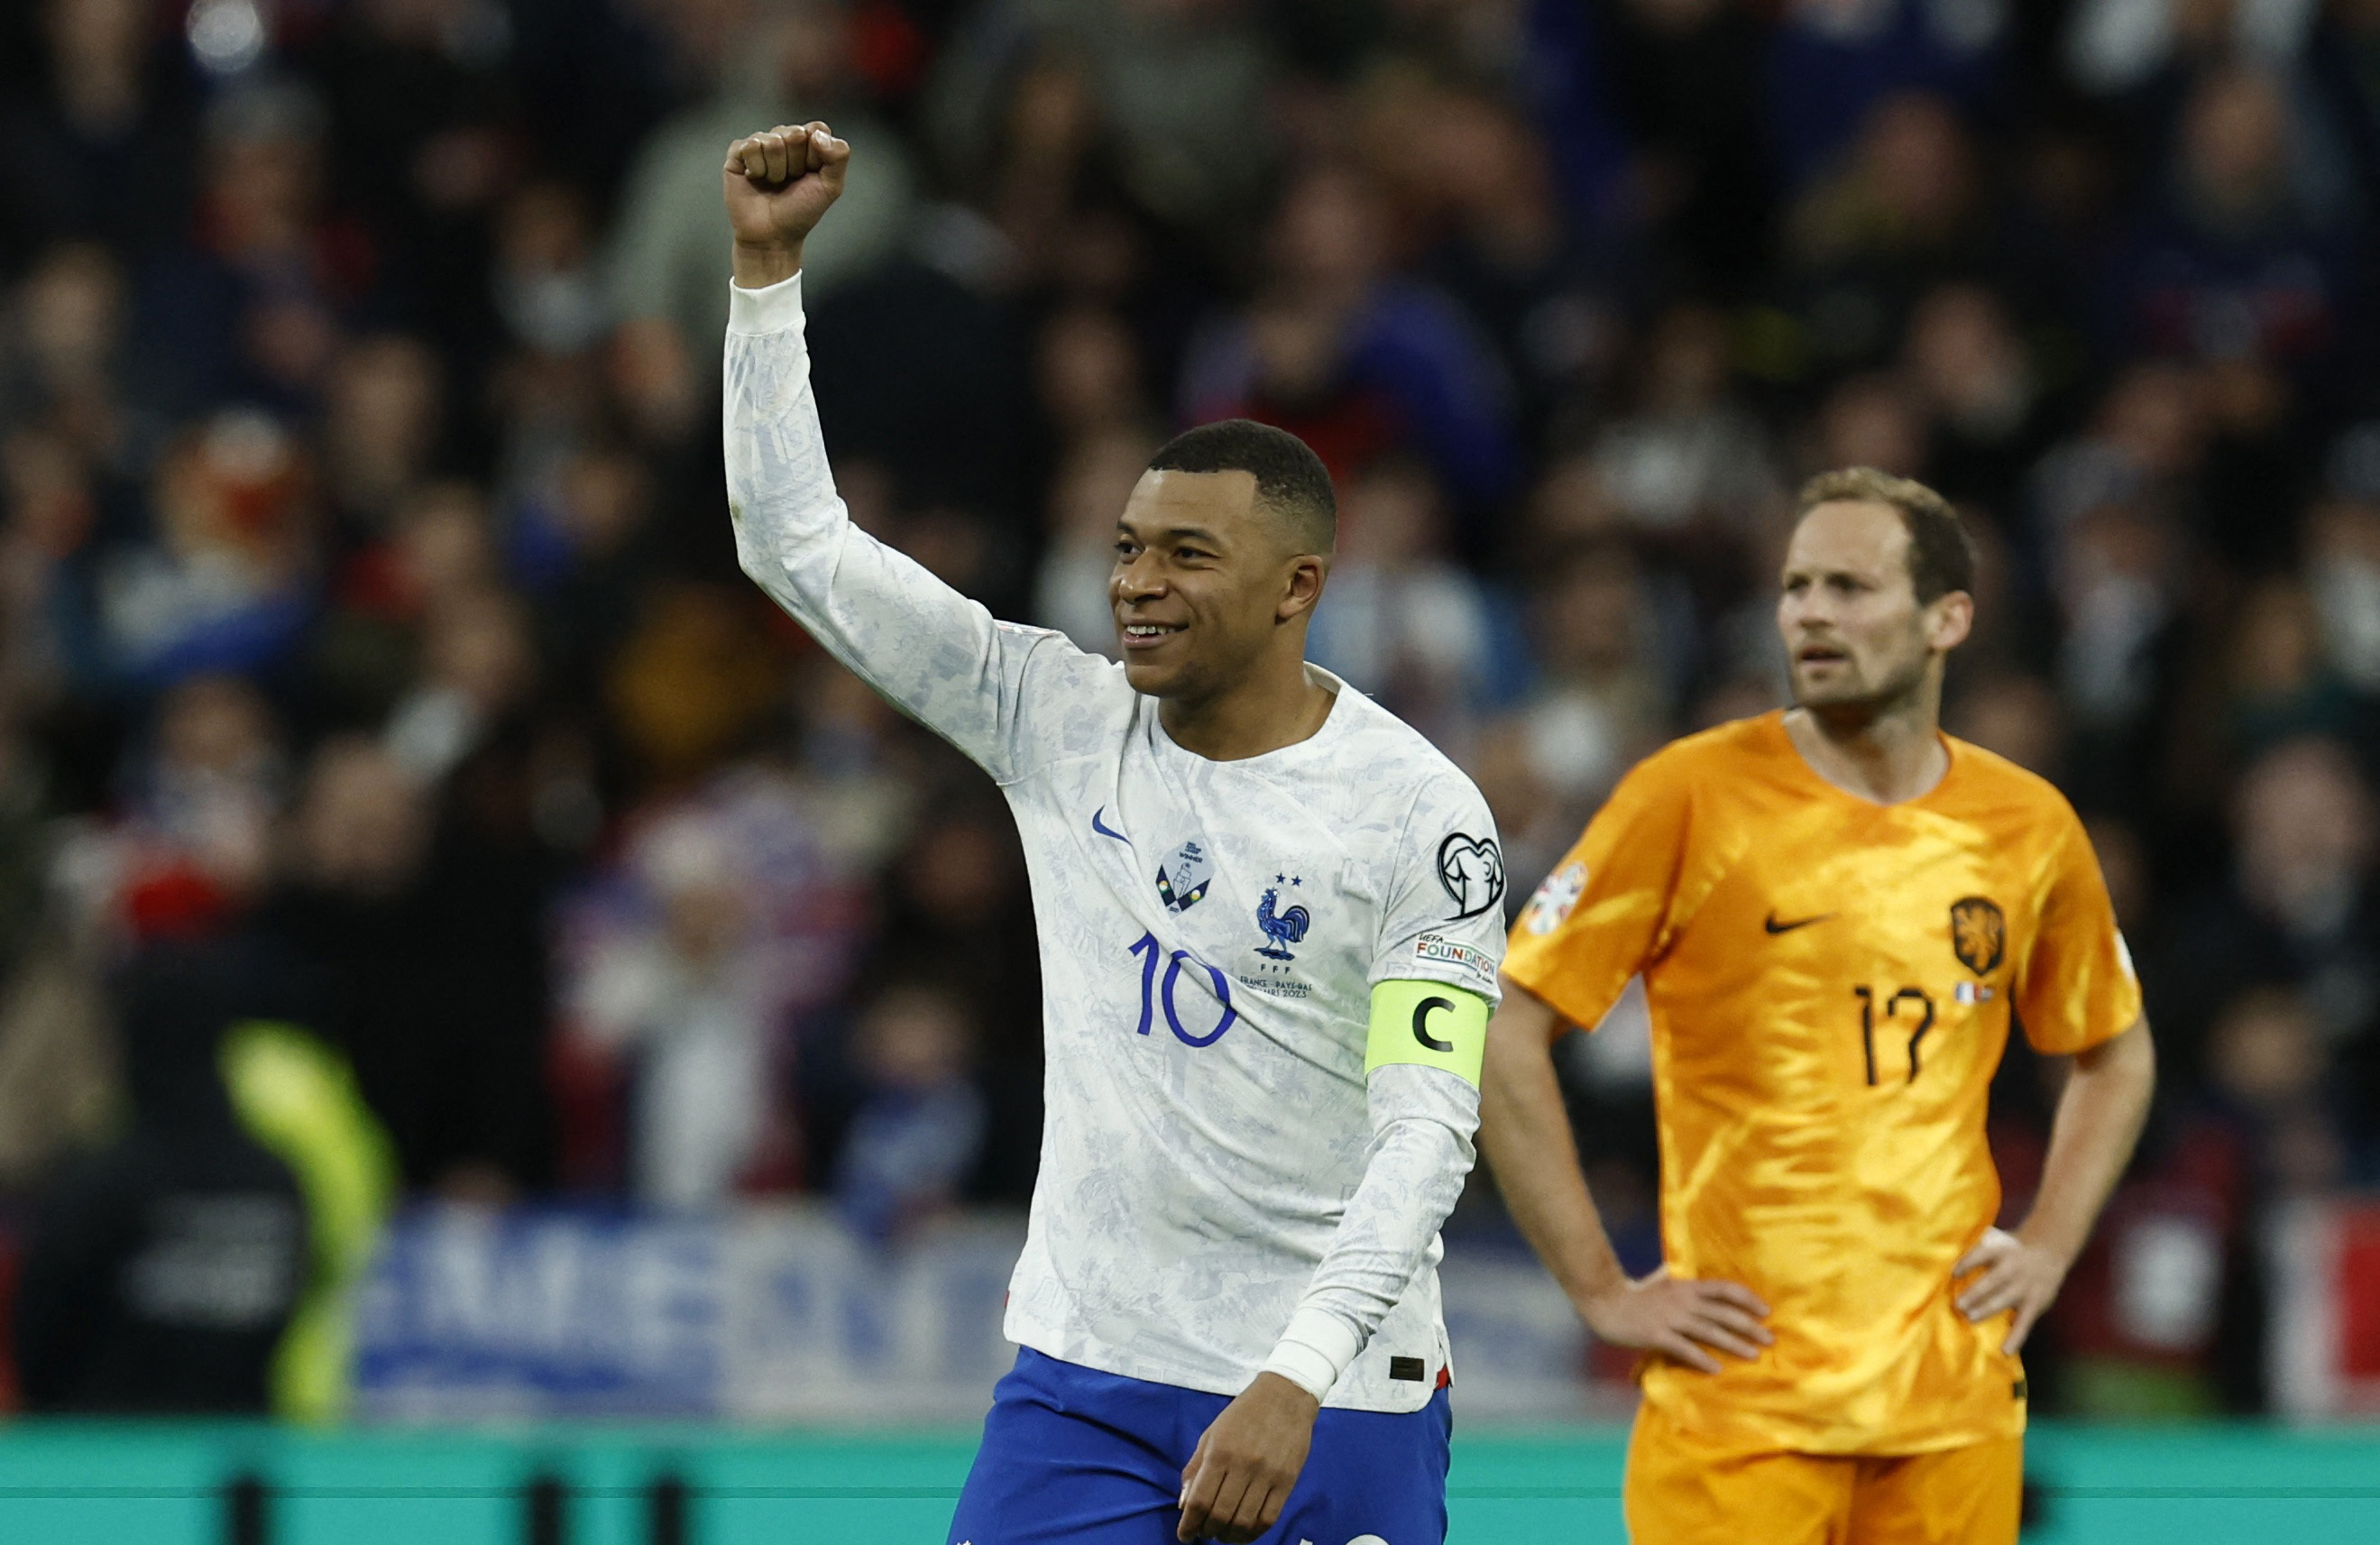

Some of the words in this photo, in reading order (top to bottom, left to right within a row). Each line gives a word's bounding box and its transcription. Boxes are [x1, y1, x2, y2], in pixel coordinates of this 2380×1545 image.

[1419, 933, 1444, 943] UEFA
[1417, 943, 1495, 977] FOUNDATION
[1127, 930, 1237, 1048] 10
[1240, 976, 1267, 988] FRANCE
[1282, 989, 1307, 998] 2023
[1412, 997, 1456, 1053] C
[1855, 987, 1934, 1086] 17
